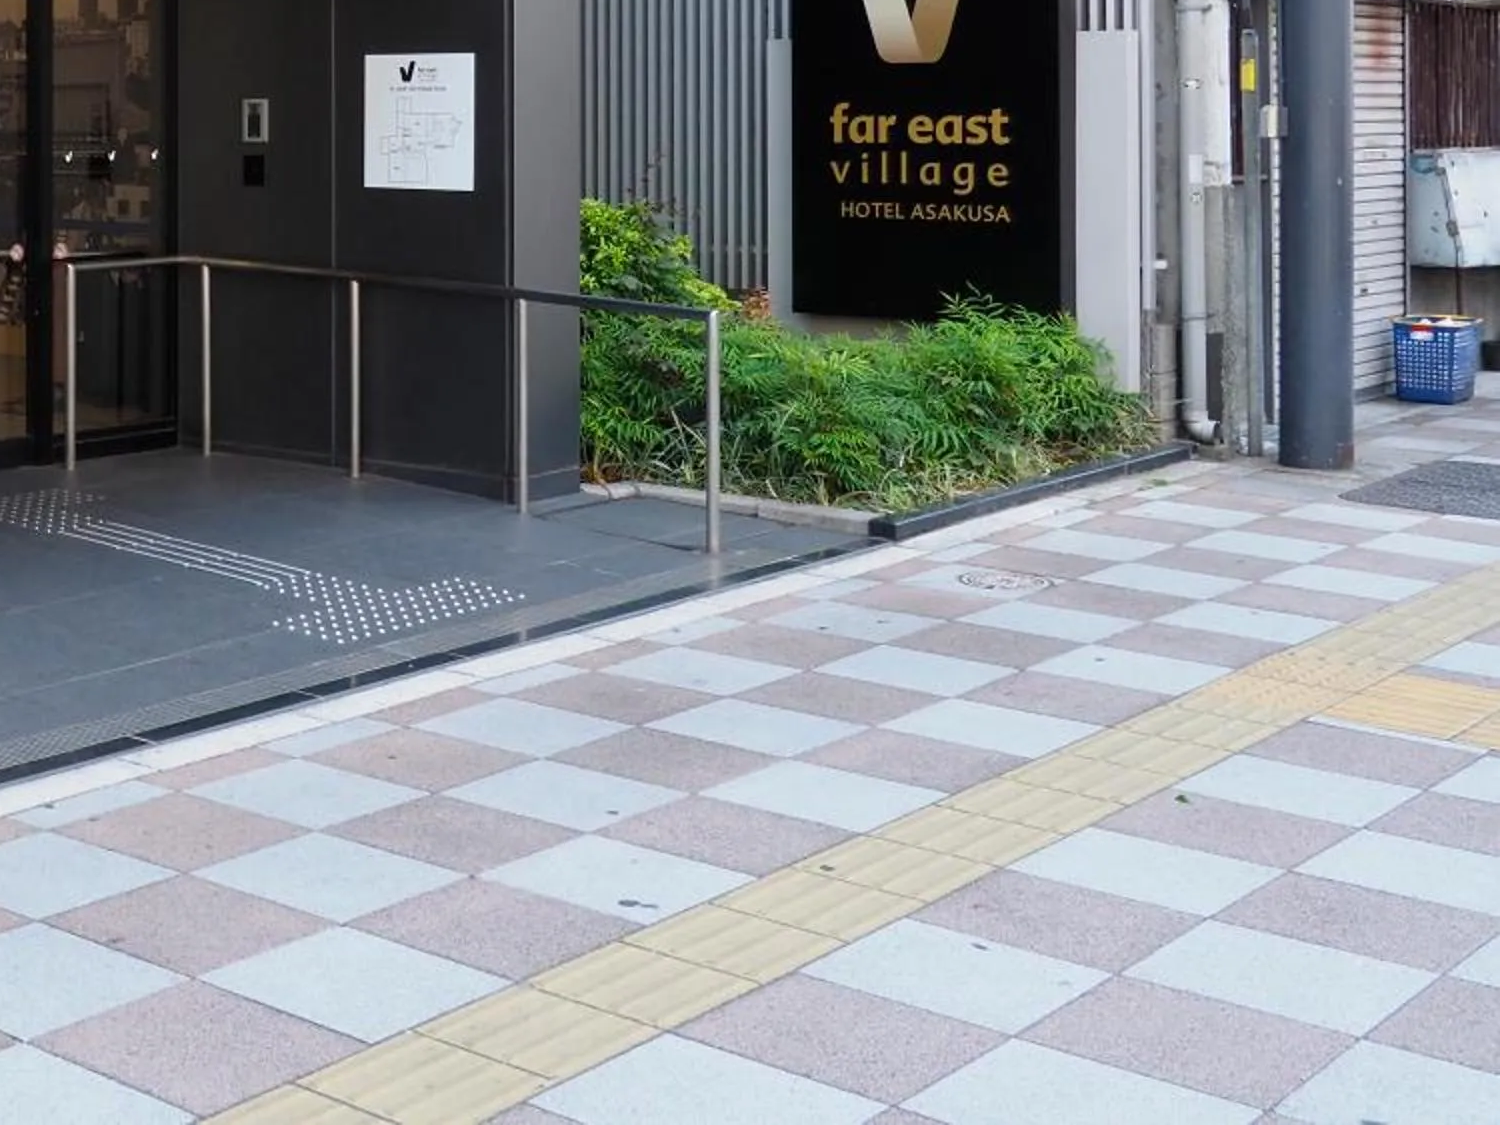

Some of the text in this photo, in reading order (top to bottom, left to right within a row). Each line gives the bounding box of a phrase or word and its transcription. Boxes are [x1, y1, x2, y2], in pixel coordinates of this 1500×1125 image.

[829, 102, 1011, 145] far east
[829, 151, 1010, 196] village
[840, 201, 1012, 223] HOTEL ASAKUSA
